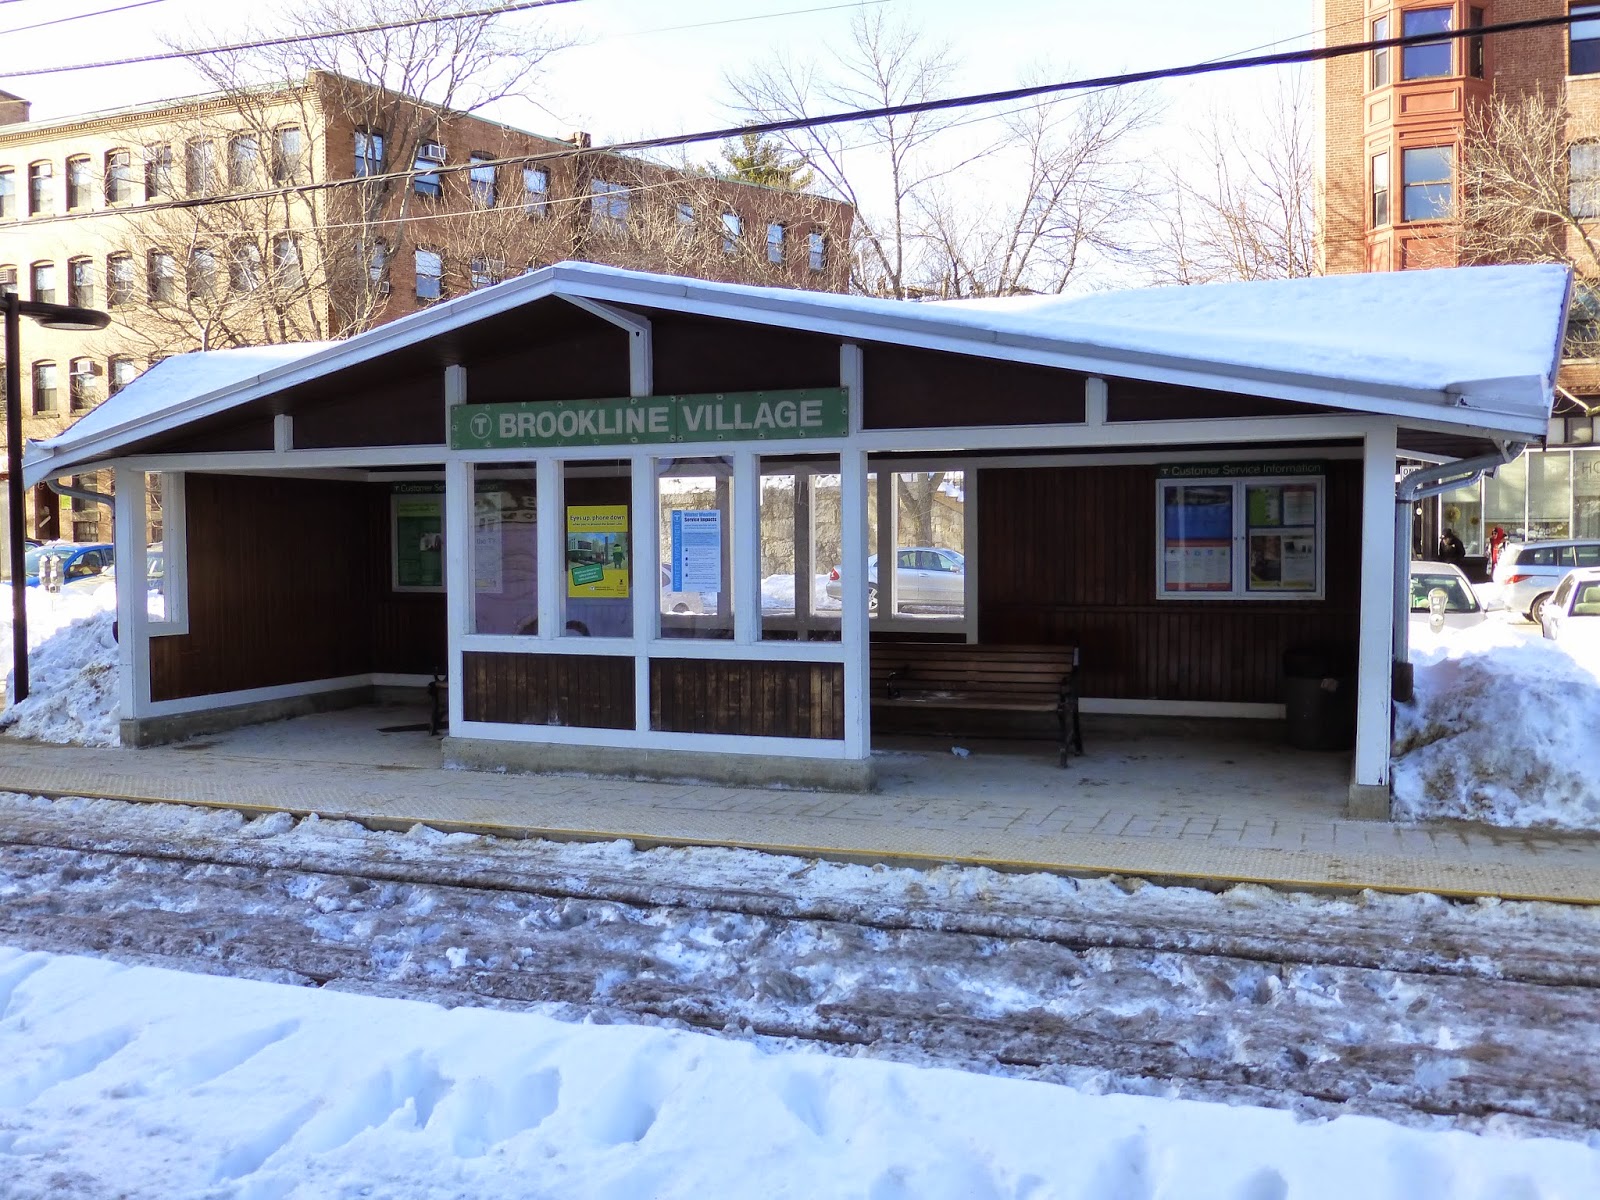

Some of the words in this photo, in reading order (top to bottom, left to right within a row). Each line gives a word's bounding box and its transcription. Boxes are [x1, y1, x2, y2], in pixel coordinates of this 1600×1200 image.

[499, 406, 669, 438] BROOKLINE
[682, 399, 823, 432] VILLAGE
[1171, 466, 1219, 476] Customer
[1222, 465, 1260, 475] Service
[1263, 464, 1321, 474] Information
[400, 484, 432, 493] Customer
